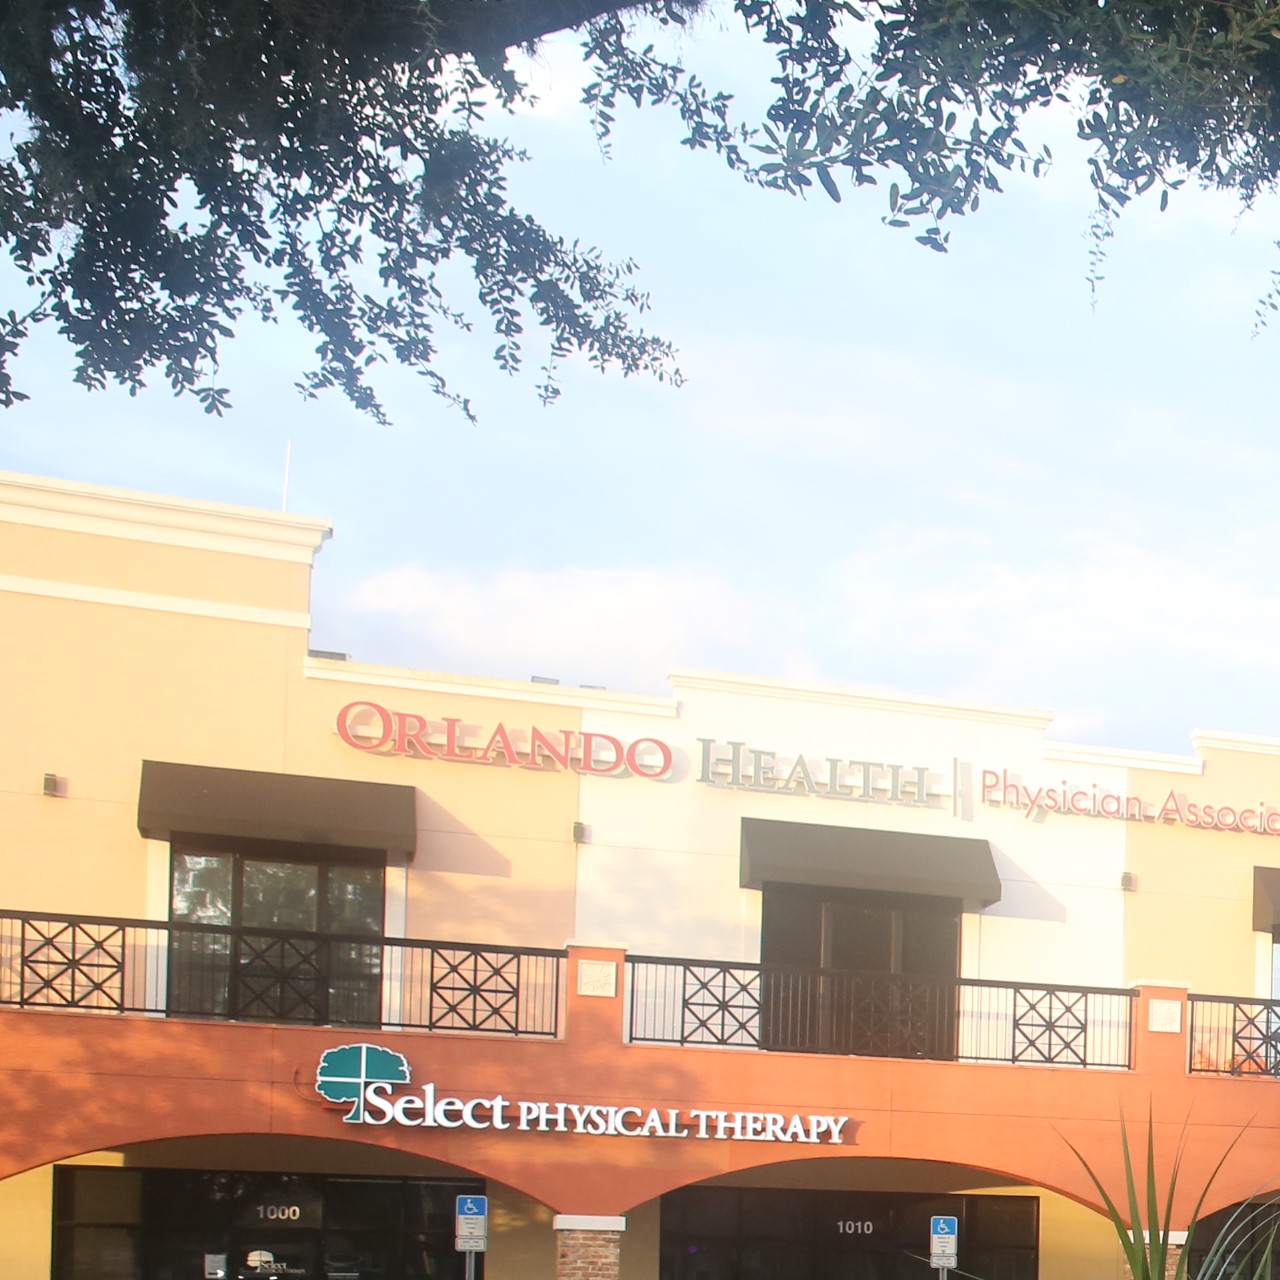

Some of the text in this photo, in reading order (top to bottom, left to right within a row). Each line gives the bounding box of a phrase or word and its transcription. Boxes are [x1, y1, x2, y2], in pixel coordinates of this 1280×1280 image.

[336, 701, 673, 778] ORLANDO
[696, 737, 930, 803] HEALTH
[981, 768, 1143, 819] Physician
[364, 1082, 850, 1144] Select PHYSICAL THERAPY
[256, 1205, 300, 1220] 1000
[837, 1220, 874, 1234] 1010
